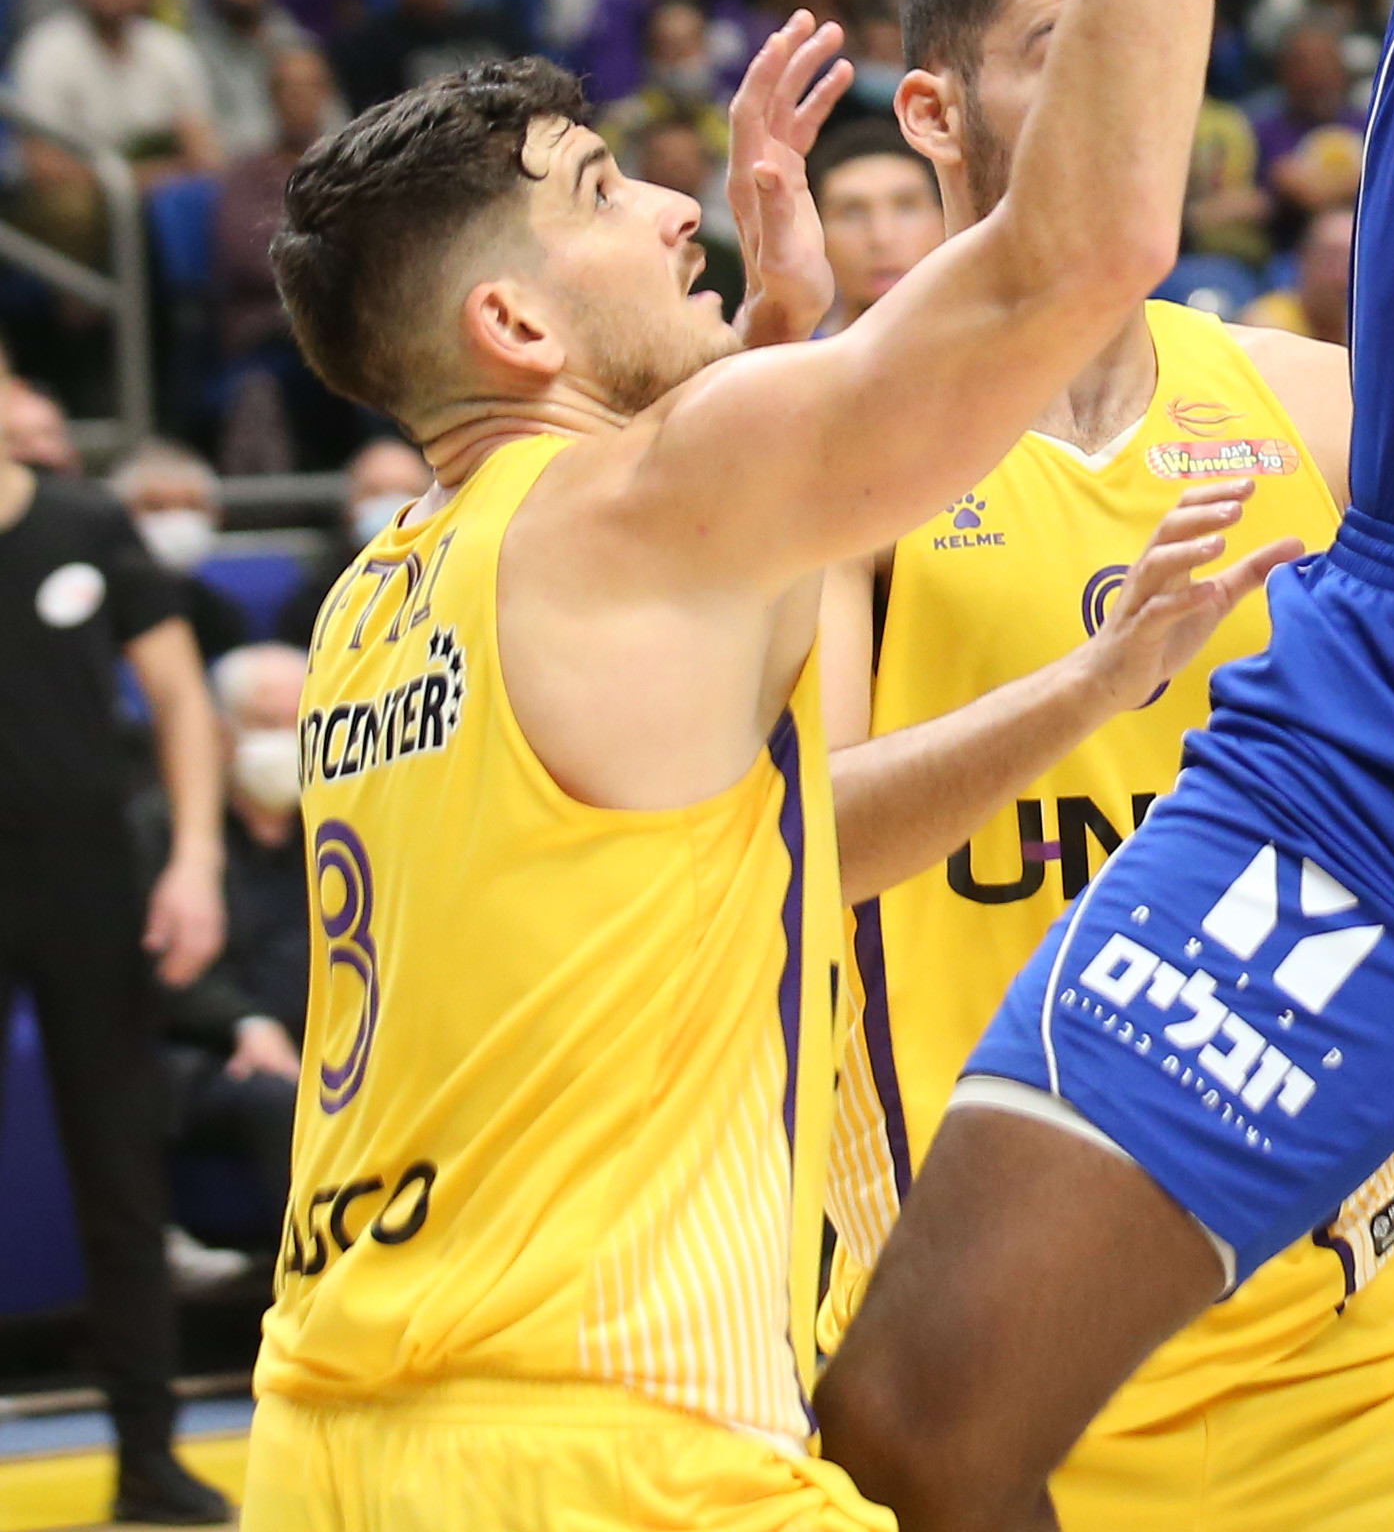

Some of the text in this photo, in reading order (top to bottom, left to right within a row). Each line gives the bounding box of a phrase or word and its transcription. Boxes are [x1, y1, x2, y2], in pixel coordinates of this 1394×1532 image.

[1161, 451, 1258, 474] Winner
[933, 532, 1006, 551] KELME
[315, 817, 380, 1115] 8
[1079, 931, 1317, 1118] יובלים
